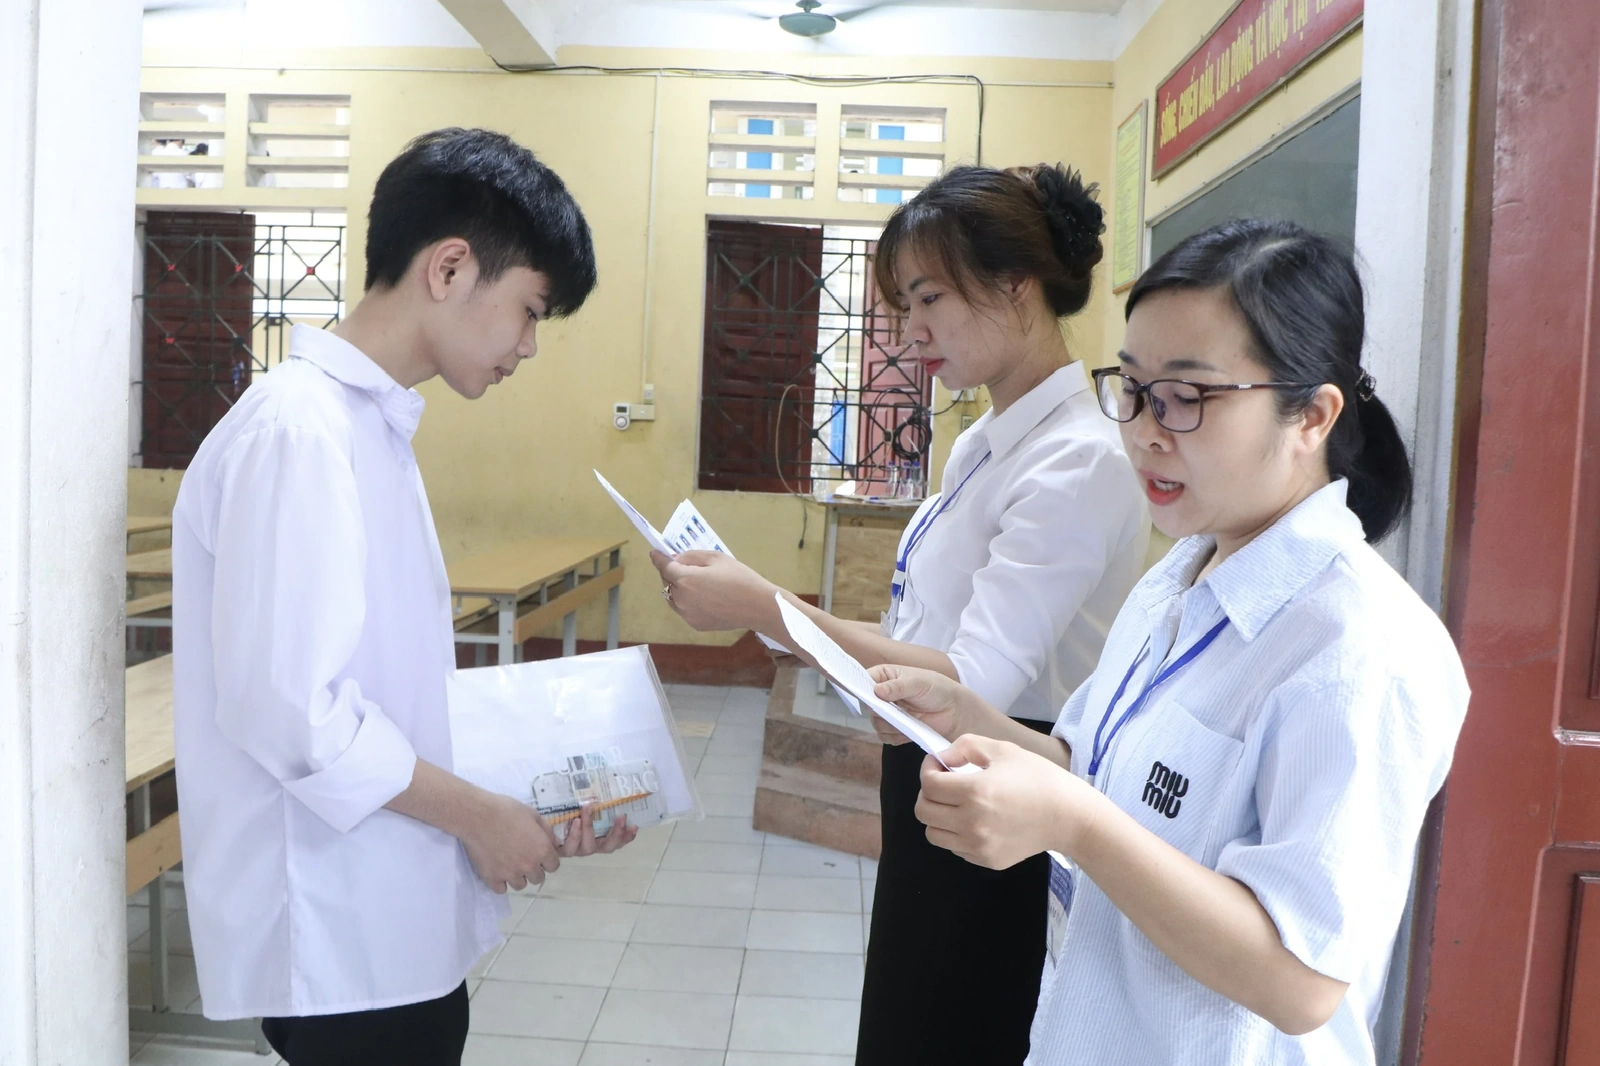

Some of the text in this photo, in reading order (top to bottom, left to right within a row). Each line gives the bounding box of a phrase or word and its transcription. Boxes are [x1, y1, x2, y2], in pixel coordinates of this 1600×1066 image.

[1216, 48, 1230, 101] LAO
[1230, 26, 1254, 92] ĐỘNG
[614, 770, 660, 798] BAG
